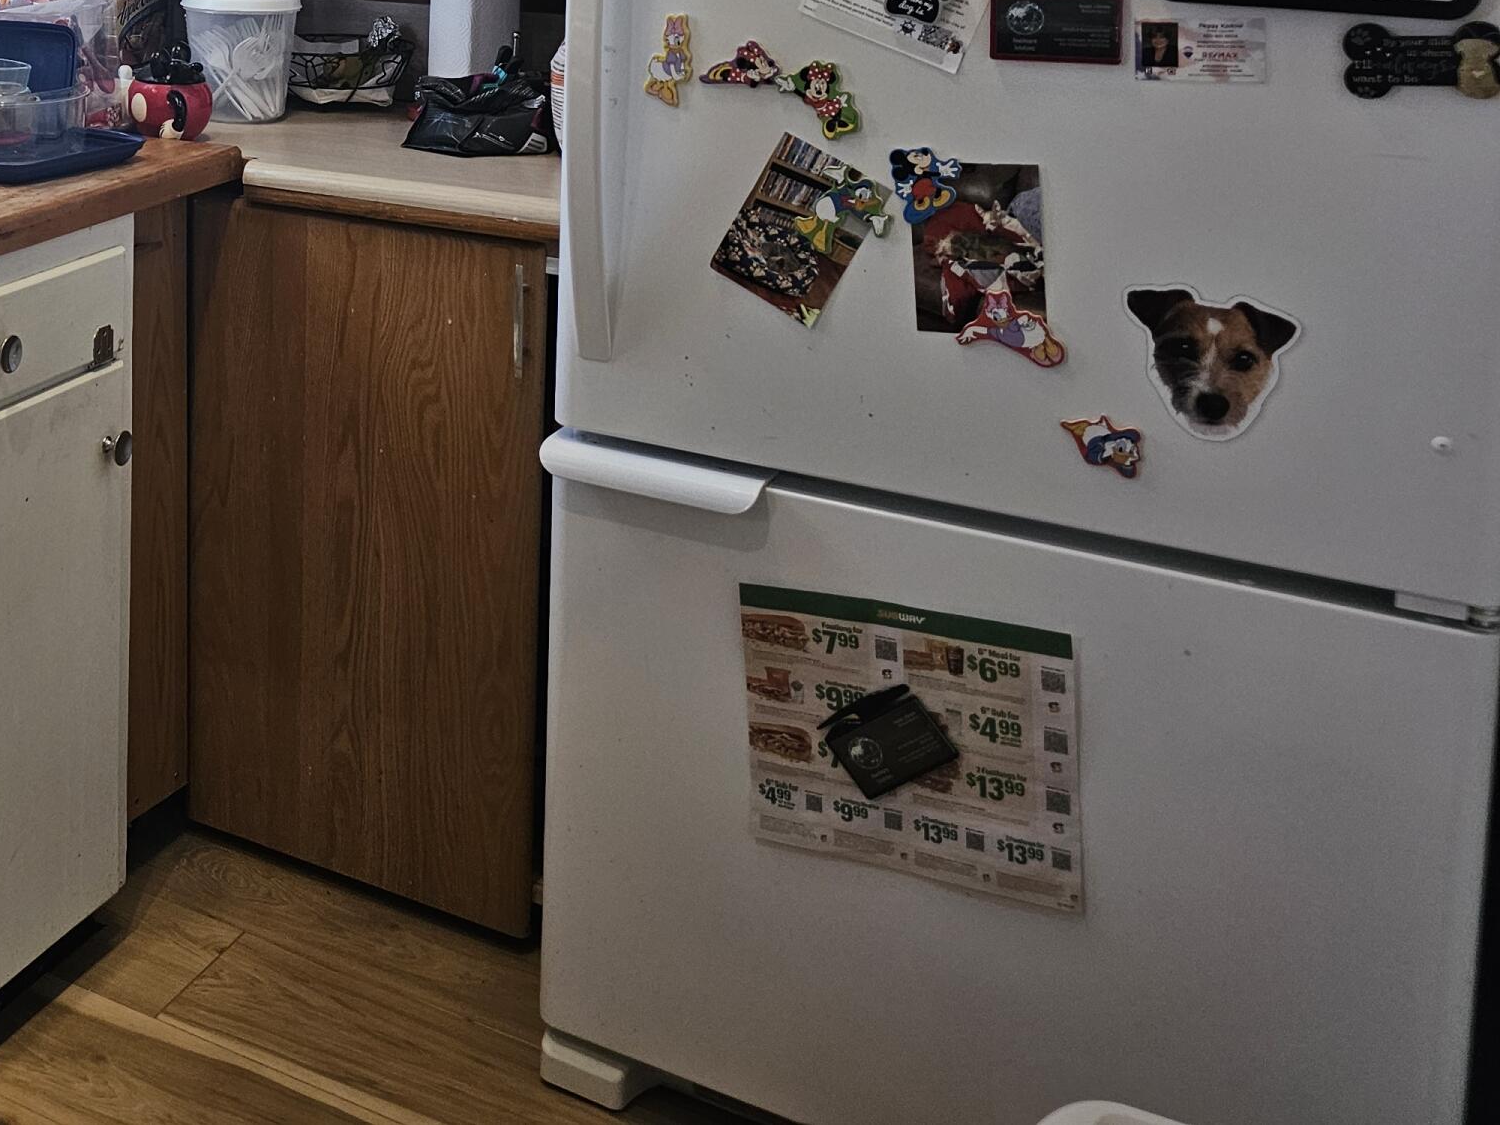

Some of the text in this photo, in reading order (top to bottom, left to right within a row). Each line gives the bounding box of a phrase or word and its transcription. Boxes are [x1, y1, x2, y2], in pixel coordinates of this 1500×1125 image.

[1202, 51, 1238, 59] RE/MAX
[1352, 75, 1382, 83] want
[1388, 75, 1400, 83] to
[878, 609, 926, 624] SUBWAY
